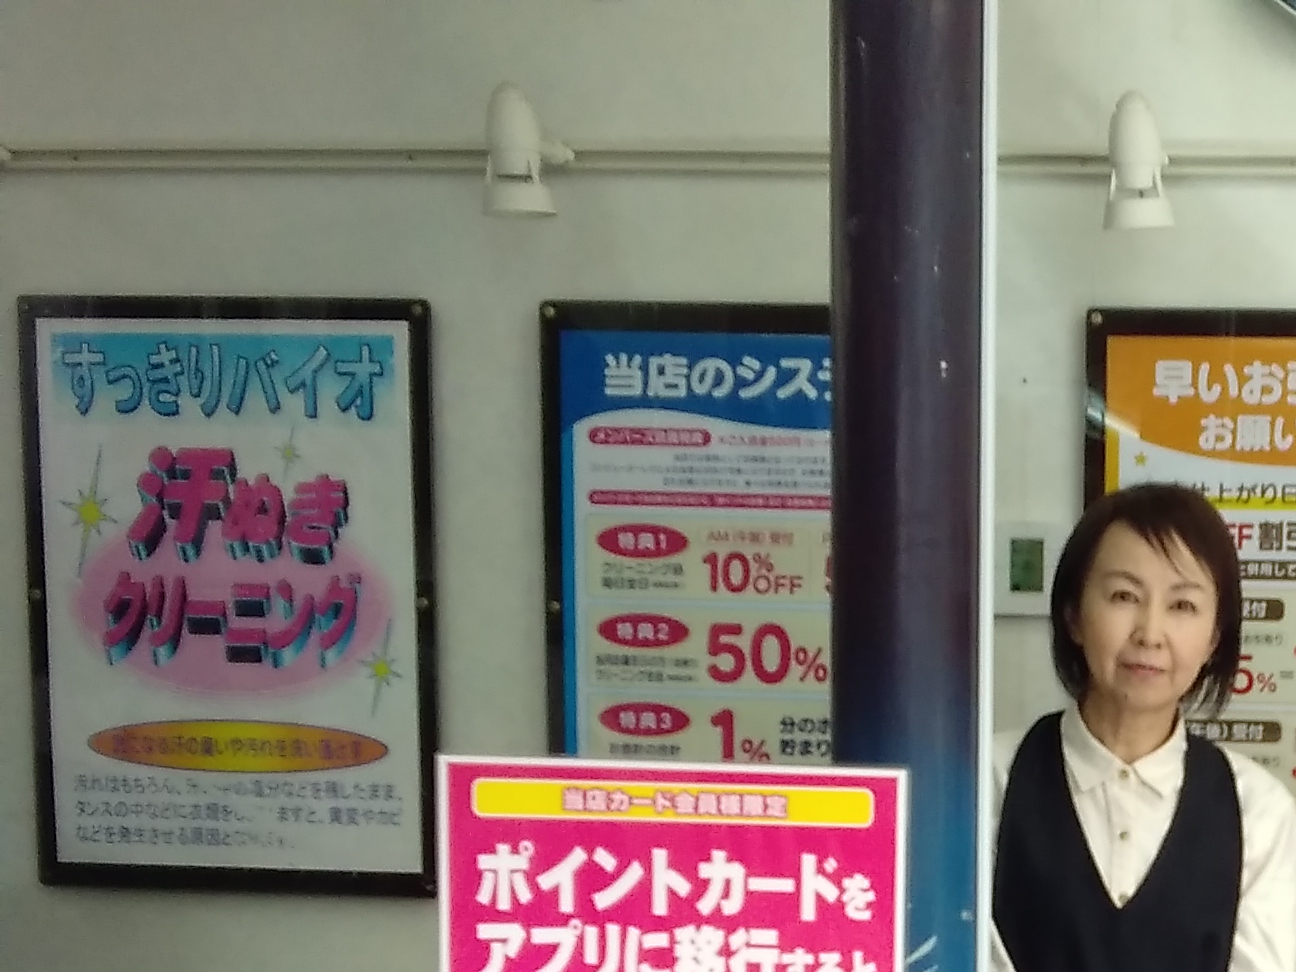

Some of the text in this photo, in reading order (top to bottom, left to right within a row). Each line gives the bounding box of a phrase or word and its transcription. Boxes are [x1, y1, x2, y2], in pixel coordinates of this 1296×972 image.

[62, 340, 384, 419] すっきりバイオ
[126, 446, 350, 563] 汗ぬき
[703, 551, 775, 593] 10%
[753, 575, 804, 594] OFF
[104, 571, 362, 669] クリーニング
[707, 622, 828, 684] 50%
[710, 708, 770, 761] 1%
[475, 842, 877, 923] ポイントカードを
